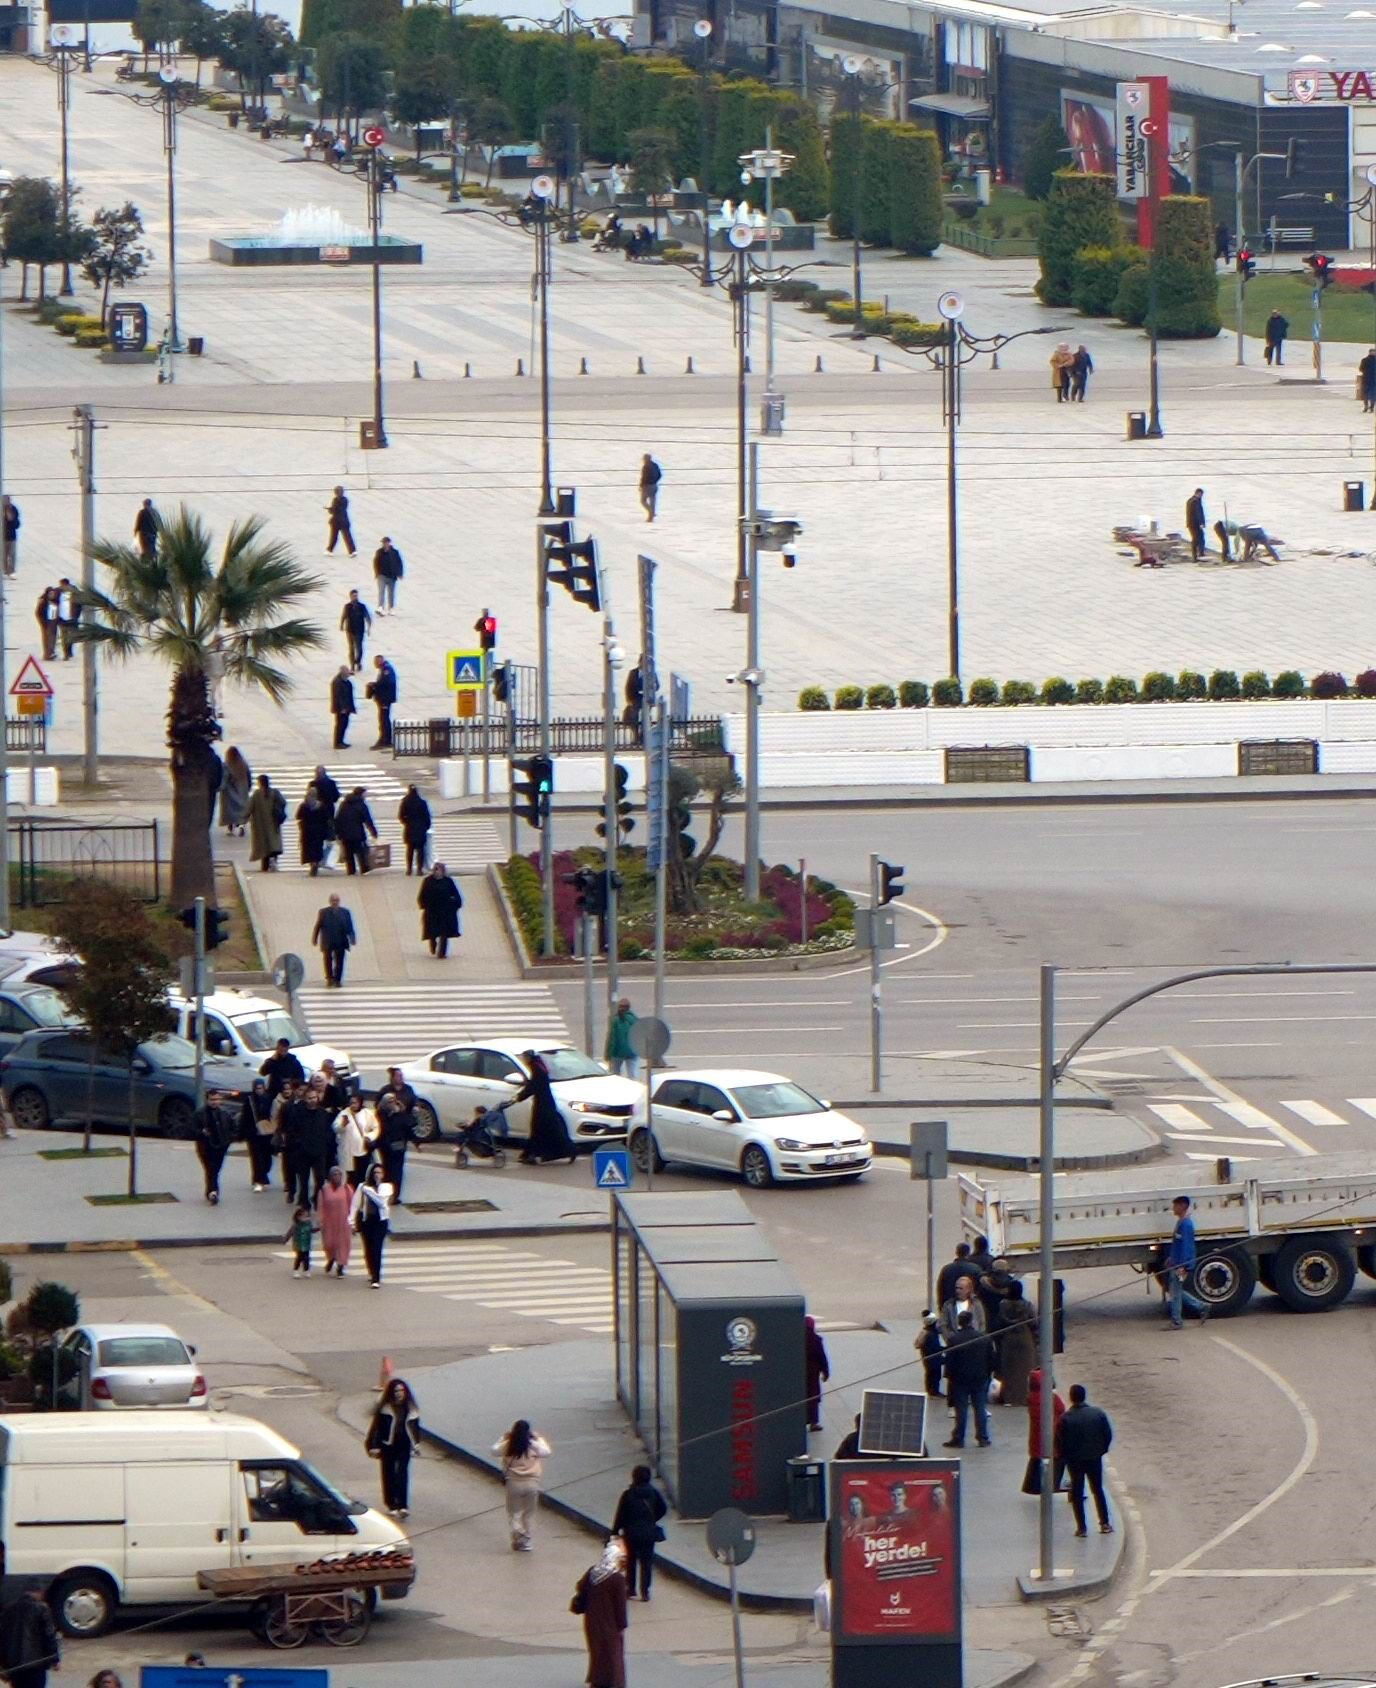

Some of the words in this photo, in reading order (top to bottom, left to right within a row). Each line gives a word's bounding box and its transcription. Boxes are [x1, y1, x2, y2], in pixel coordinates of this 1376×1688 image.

[1125, 115, 1136, 193] YABANCILAR
[864, 1536, 897, 1551] her
[864, 1541, 928, 1568] yerde!
